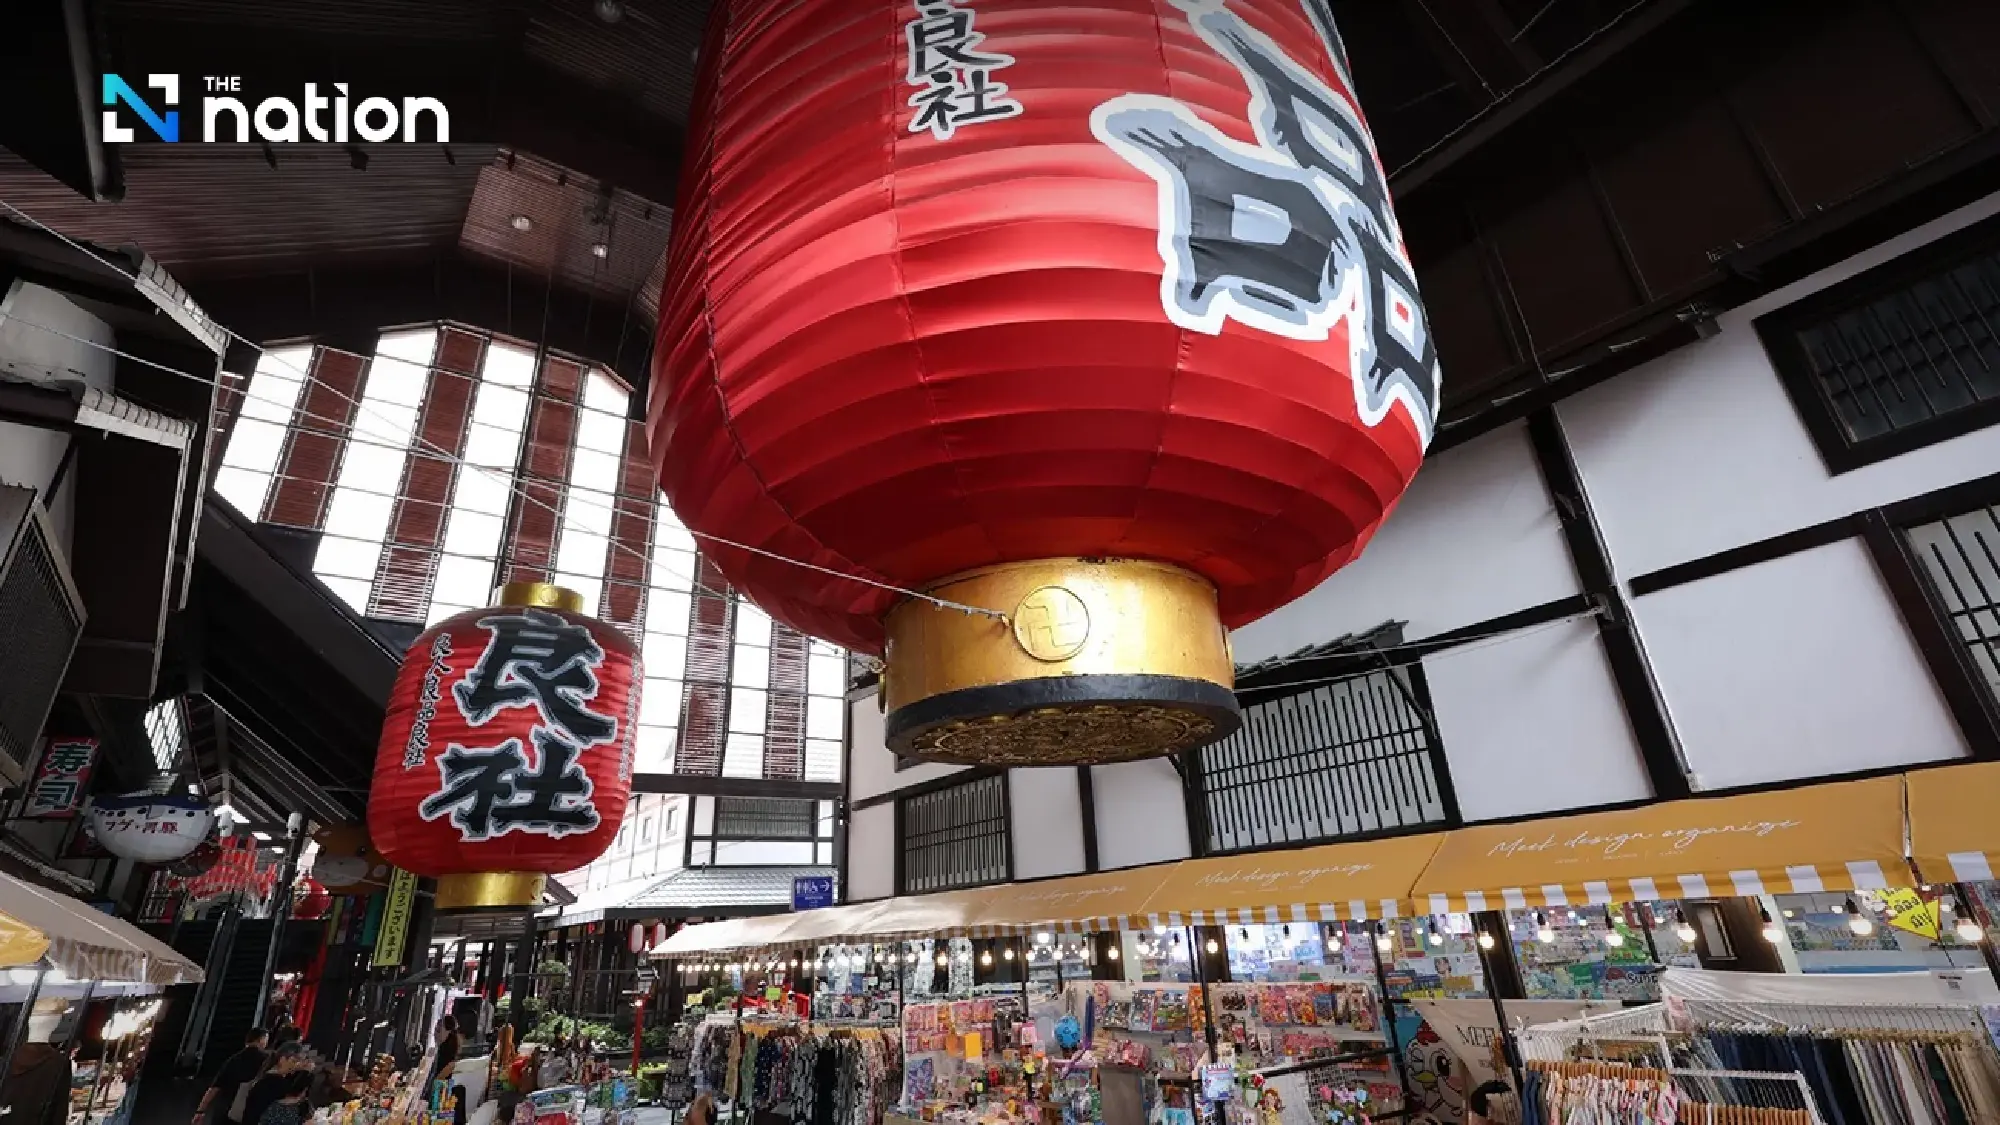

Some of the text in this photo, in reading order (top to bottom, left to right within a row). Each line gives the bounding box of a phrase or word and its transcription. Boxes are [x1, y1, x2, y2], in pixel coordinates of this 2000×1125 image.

[907, 0, 1023, 139] 良社
[35, 742, 93, 809] 寿司
[418, 609, 618, 841] 良社
[1564, 830, 1653, 853] design
[1662, 820, 1801, 848] organize
